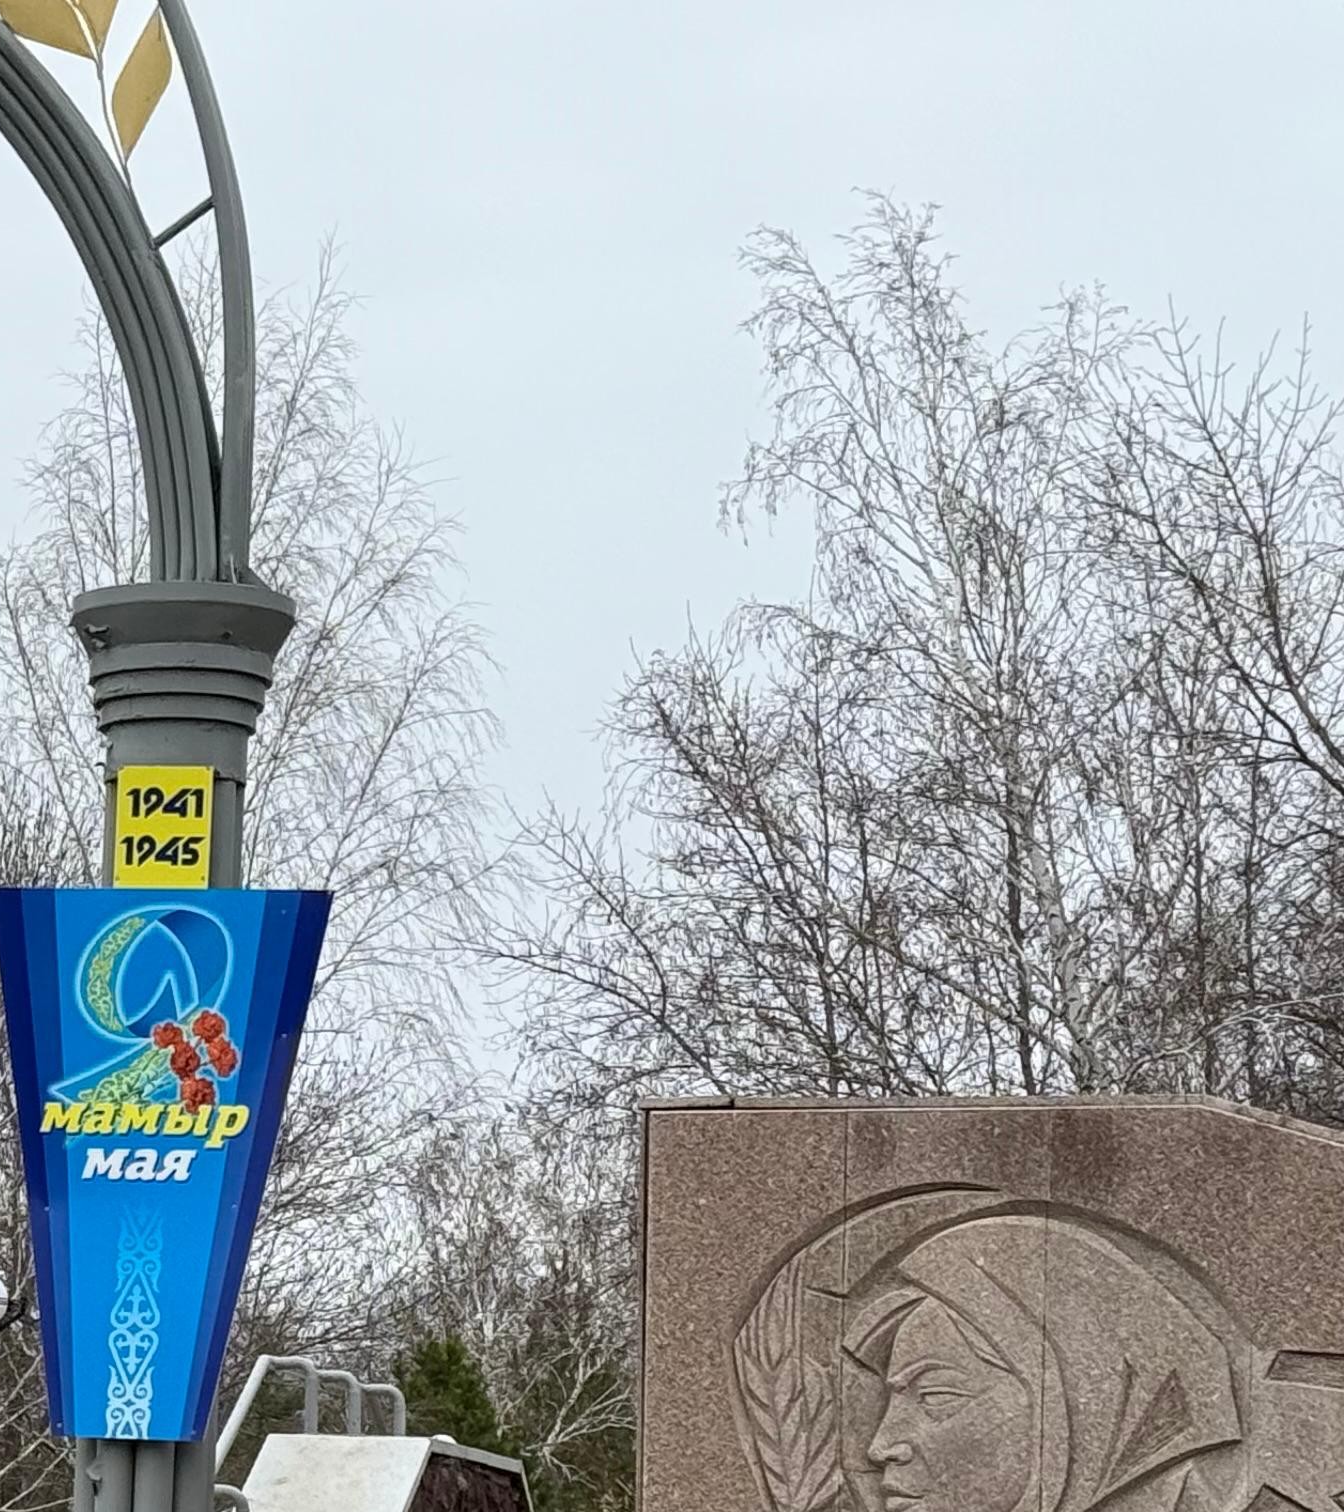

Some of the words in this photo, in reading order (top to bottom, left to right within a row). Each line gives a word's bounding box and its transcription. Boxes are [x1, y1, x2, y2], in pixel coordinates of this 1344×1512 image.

[126, 786, 205, 819] 1941
[120, 834, 207, 868] 1945
[39, 1101, 250, 1149] мамыр
[81, 1147, 199, 1181] мая
